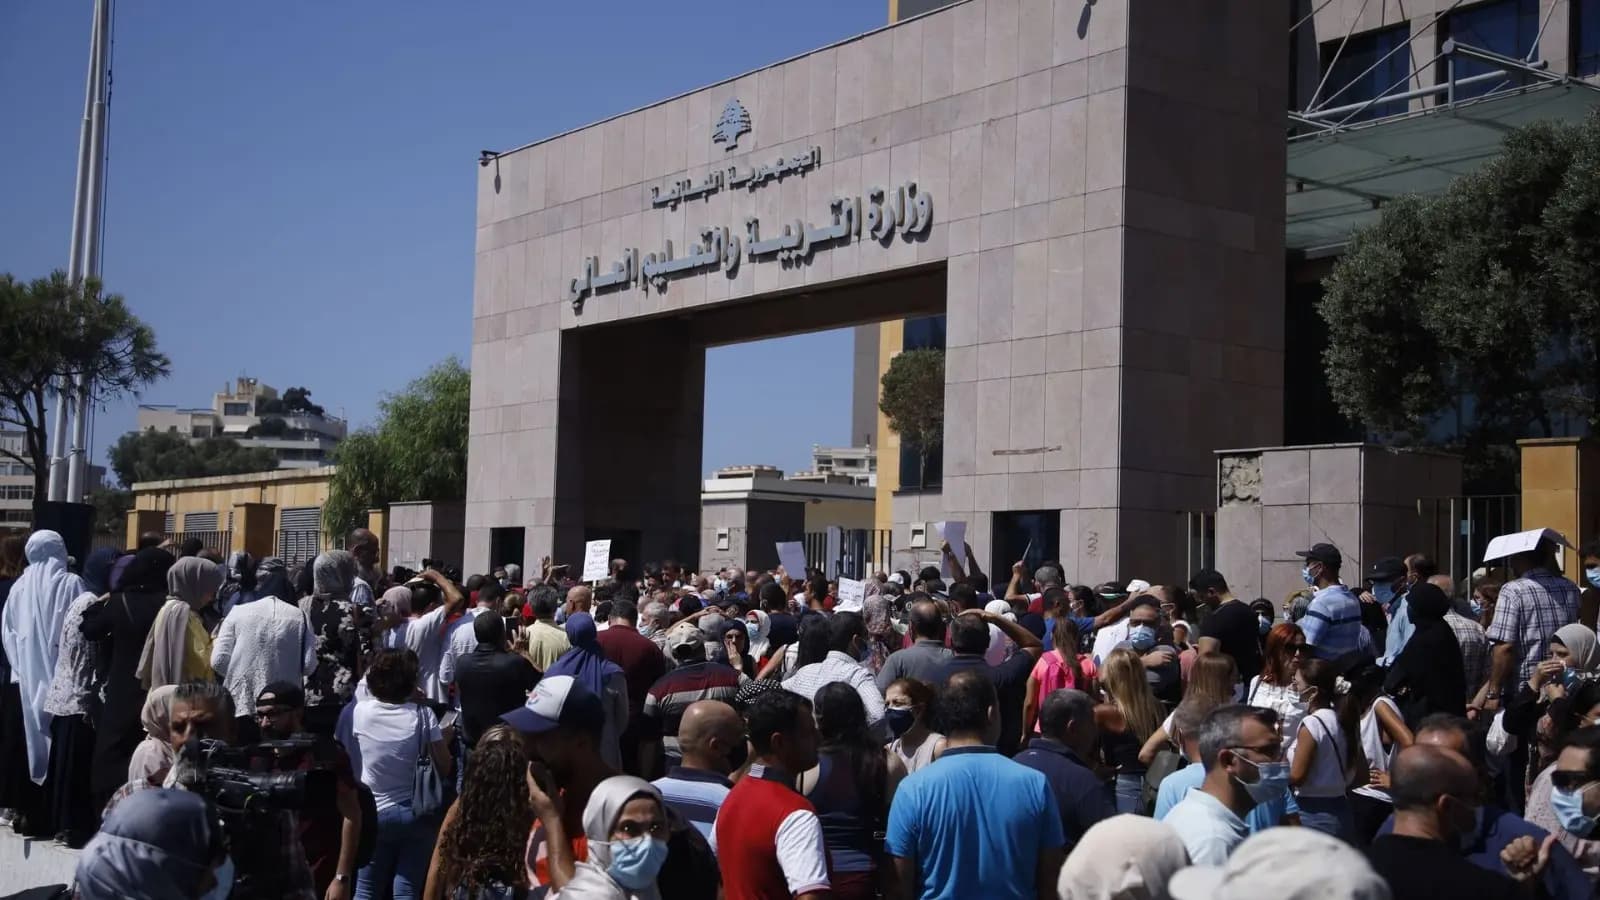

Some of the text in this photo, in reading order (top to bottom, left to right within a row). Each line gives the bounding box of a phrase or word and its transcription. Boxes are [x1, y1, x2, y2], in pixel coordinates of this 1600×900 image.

[651, 145, 821, 209] الجمهورية اللبنانية
[569, 181, 933, 312] وزارة التربية والتعليم العالي
